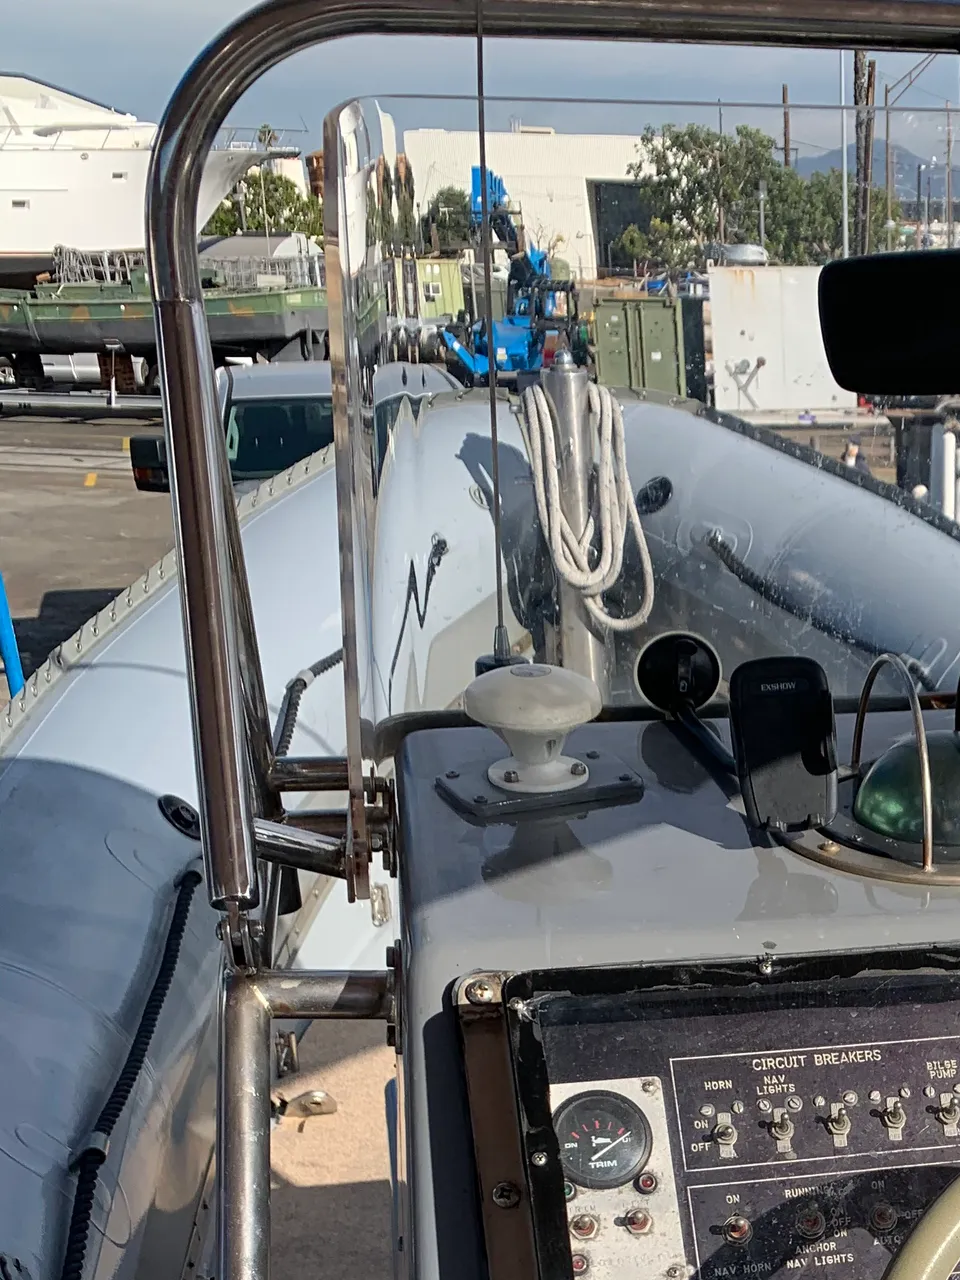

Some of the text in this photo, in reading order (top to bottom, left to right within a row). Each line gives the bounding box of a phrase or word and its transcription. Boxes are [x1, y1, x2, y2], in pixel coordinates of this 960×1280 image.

[760, 681, 797, 691] EXSHOW
[752, 1050, 882, 1071] CIRCUIT BREAKERS
[926, 1059, 958, 1071] BILGE
[929, 1068, 957, 1080] PUMP
[704, 1080, 733, 1091] HORN
[763, 1075, 785, 1086] NAV
[756, 1084, 796, 1096] LIGHTS
[694, 1119, 709, 1129] ON
[691, 1142, 712, 1152] OFF
[589, 1160, 618, 1169] TRIM
[871, 1180, 885, 1191] ON
[784, 1185, 829, 1199] RUNNING
[726, 1194, 740, 1204] ON
[832, 1216, 851, 1227] OFF
[834, 1228, 848, 1238] ON
[795, 1242, 837, 1255] ANCHOR
[787, 1254, 854, 1270] NAV LIGHTS
[715, 1262, 772, 1277] NAV HORN
